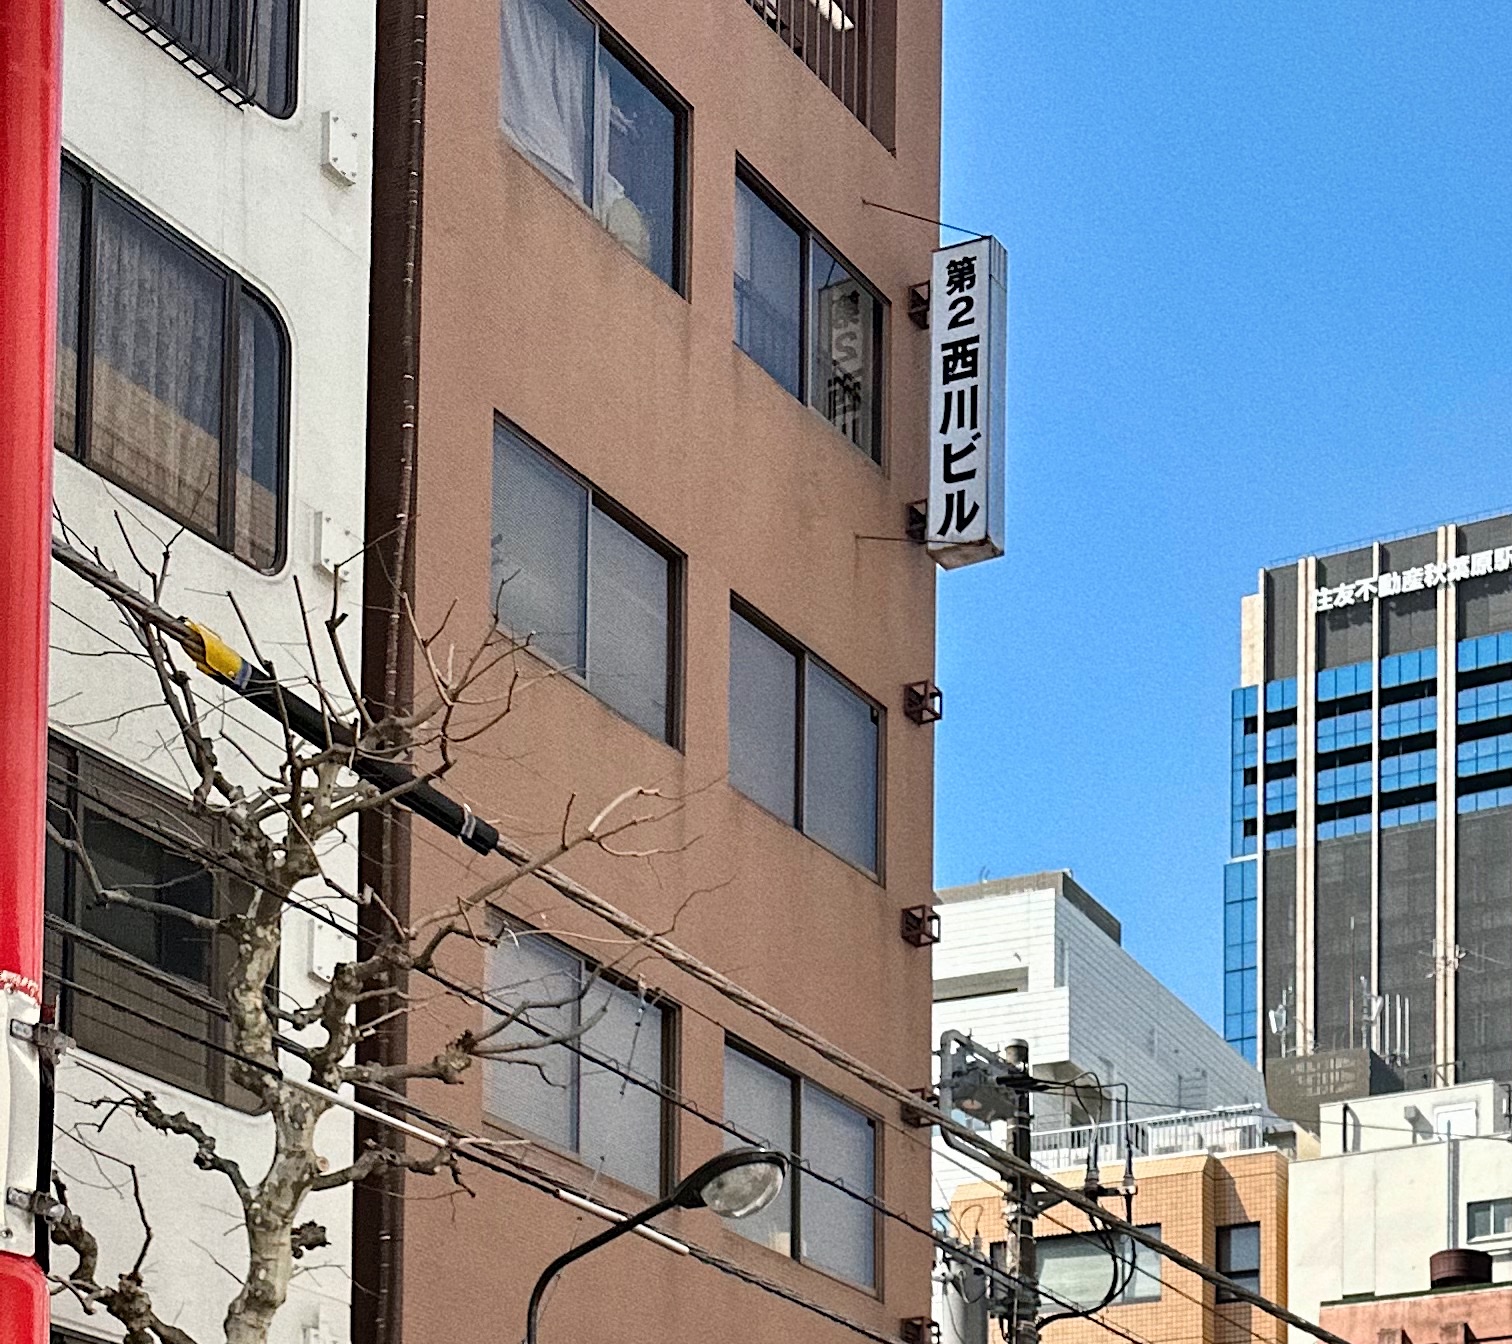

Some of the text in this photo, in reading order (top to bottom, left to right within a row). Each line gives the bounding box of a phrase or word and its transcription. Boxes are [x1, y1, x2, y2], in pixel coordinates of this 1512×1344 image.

[938, 256, 982, 537] 第2西川ビル
